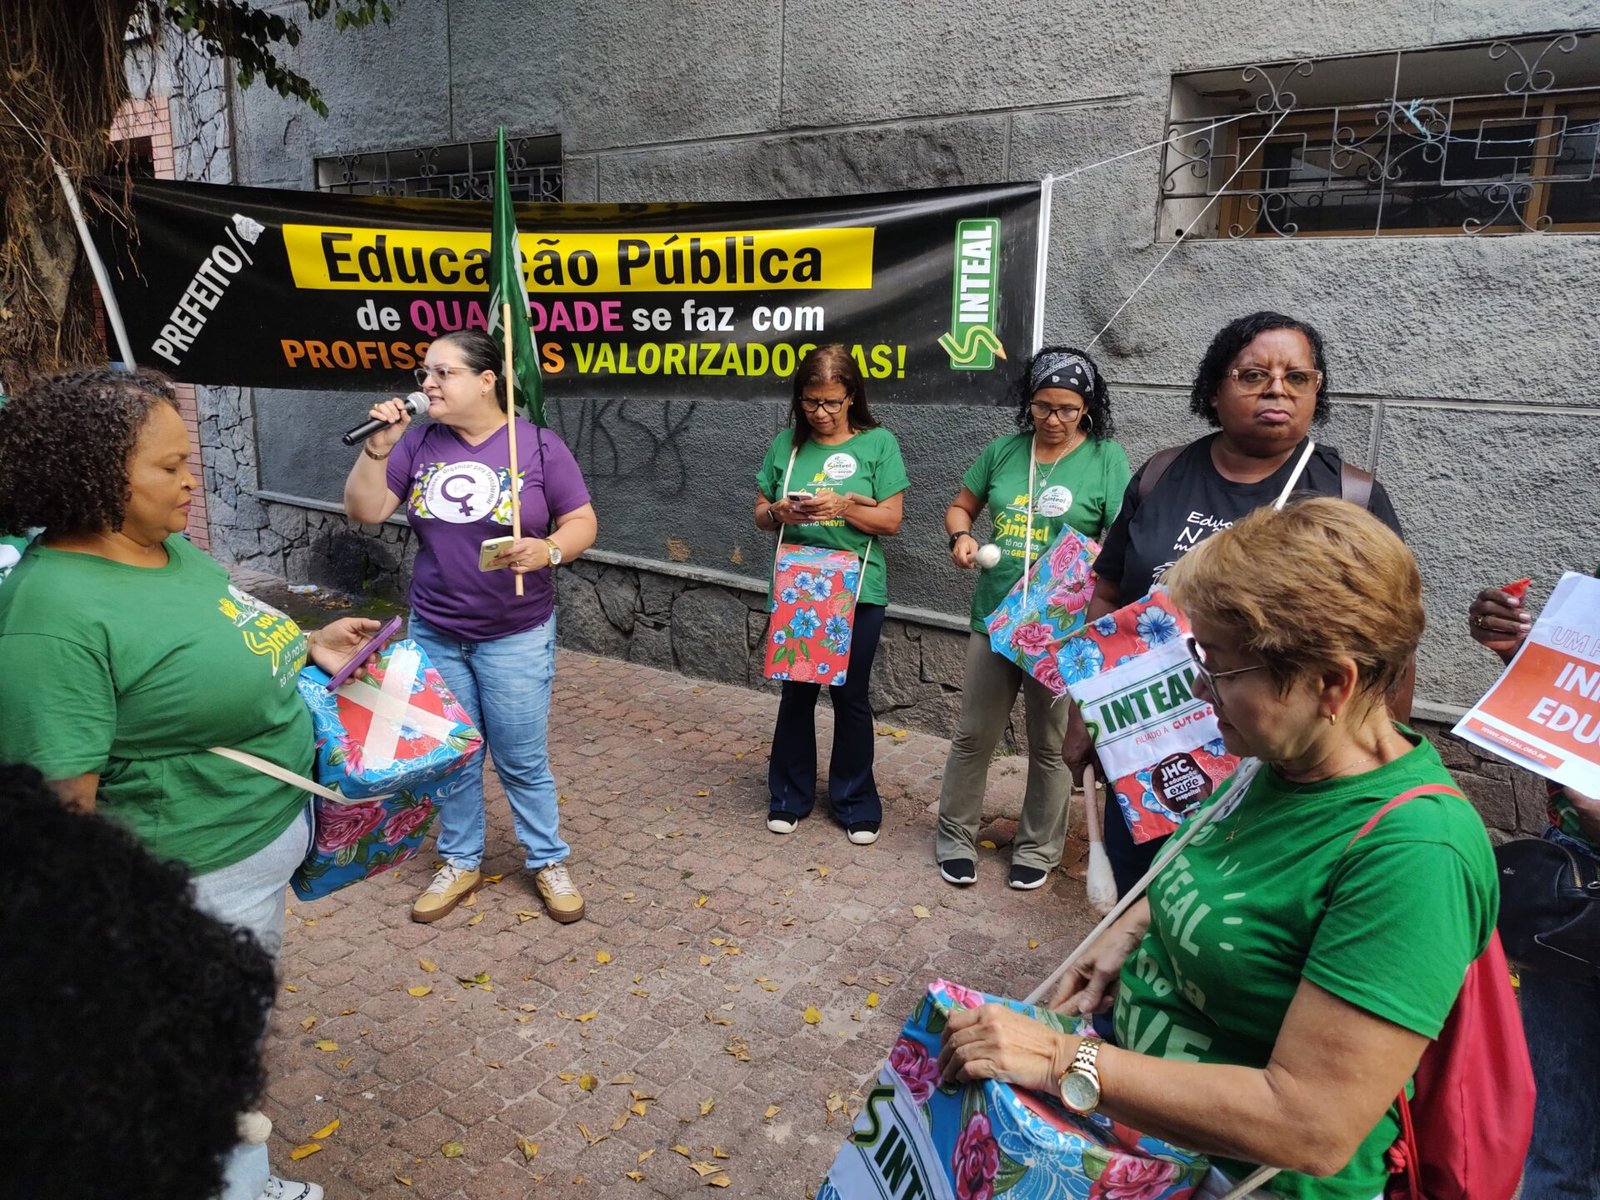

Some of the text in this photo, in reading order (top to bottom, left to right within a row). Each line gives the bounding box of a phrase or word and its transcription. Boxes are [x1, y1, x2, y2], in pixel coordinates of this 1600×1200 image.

[617, 234, 822, 285] Pública
[356, 299, 825, 337] de QUADADE se faz com
[280, 338, 566, 374] PROFISSS
[1551, 626, 1591, 654] UM
[1169, 778, 1199, 796] exige
